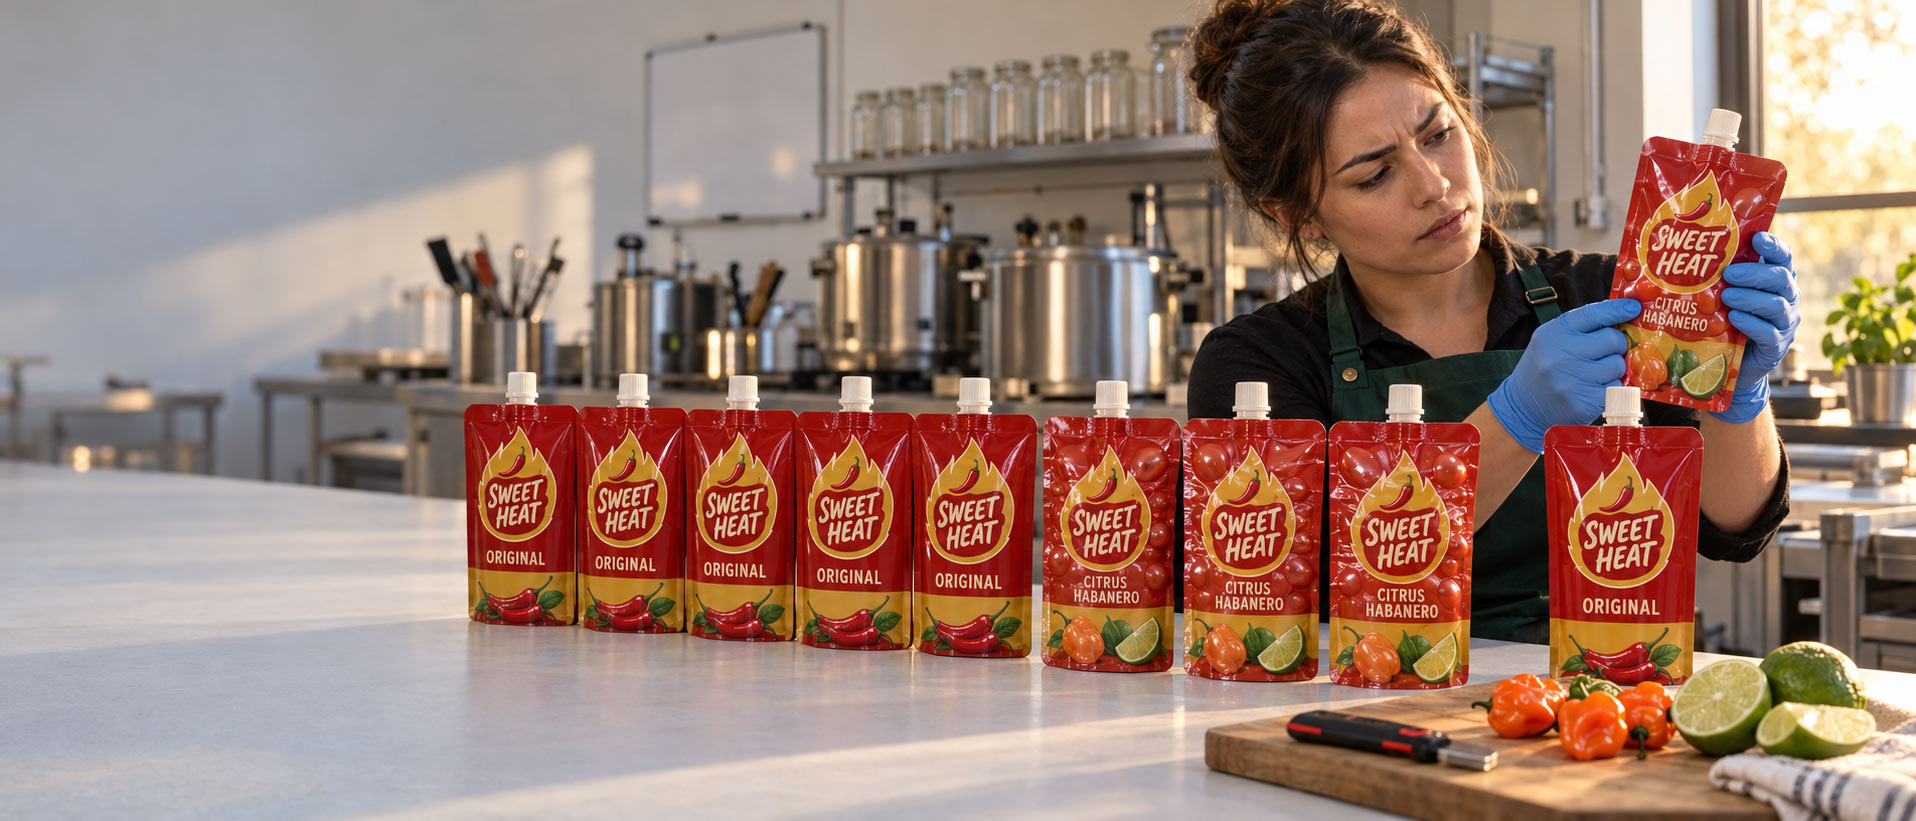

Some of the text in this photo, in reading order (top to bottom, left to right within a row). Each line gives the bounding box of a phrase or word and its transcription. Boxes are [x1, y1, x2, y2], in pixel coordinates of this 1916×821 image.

[1652, 225, 1726, 252] SWEET
[1656, 252, 1718, 277] HEAT
[1655, 297, 1697, 315] CITRUS
[1643, 310, 1707, 331] HABANERO
[488, 479, 543, 508] SWEET
[598, 484, 654, 513] SWEET
[706, 488, 764, 518] SWEET
[496, 502, 542, 528] HEAT
[606, 506, 653, 534] HEAT
[819, 492, 880, 523] SWEET
[938, 496, 1000, 528] SWEET
[1073, 505, 1136, 536] SWEET
[714, 512, 763, 540] HEAT
[828, 516, 878, 545] HEAT
[947, 520, 998, 550] HEAT
[1215, 507, 1281, 540] SWEET
[1366, 511, 1435, 546] SWEET
[1584, 514, 1658, 549] SWEET
[1084, 529, 1136, 558] HEAT
[1226, 532, 1280, 562] HEAT
[1378, 538, 1434, 569] HEAT
[1596, 541, 1657, 573] HEAT
[487, 550, 544, 565] ORIGINAL
[596, 556, 656, 571] ORIGINAL
[704, 562, 766, 578] ORIGINAL
[817, 568, 881, 584] ORIGINAL
[936, 573, 1002, 589] ORIGINAL
[1084, 576, 1126, 588] CITRUS
[1226, 581, 1270, 594] CITRUS
[1074, 589, 1139, 603] HABANERO
[1216, 596, 1283, 610] HABANERO
[1378, 588, 1424, 602] CITRUS
[1583, 598, 1659, 615] ORIGINAL
[1366, 602, 1438, 618] HABANERO
